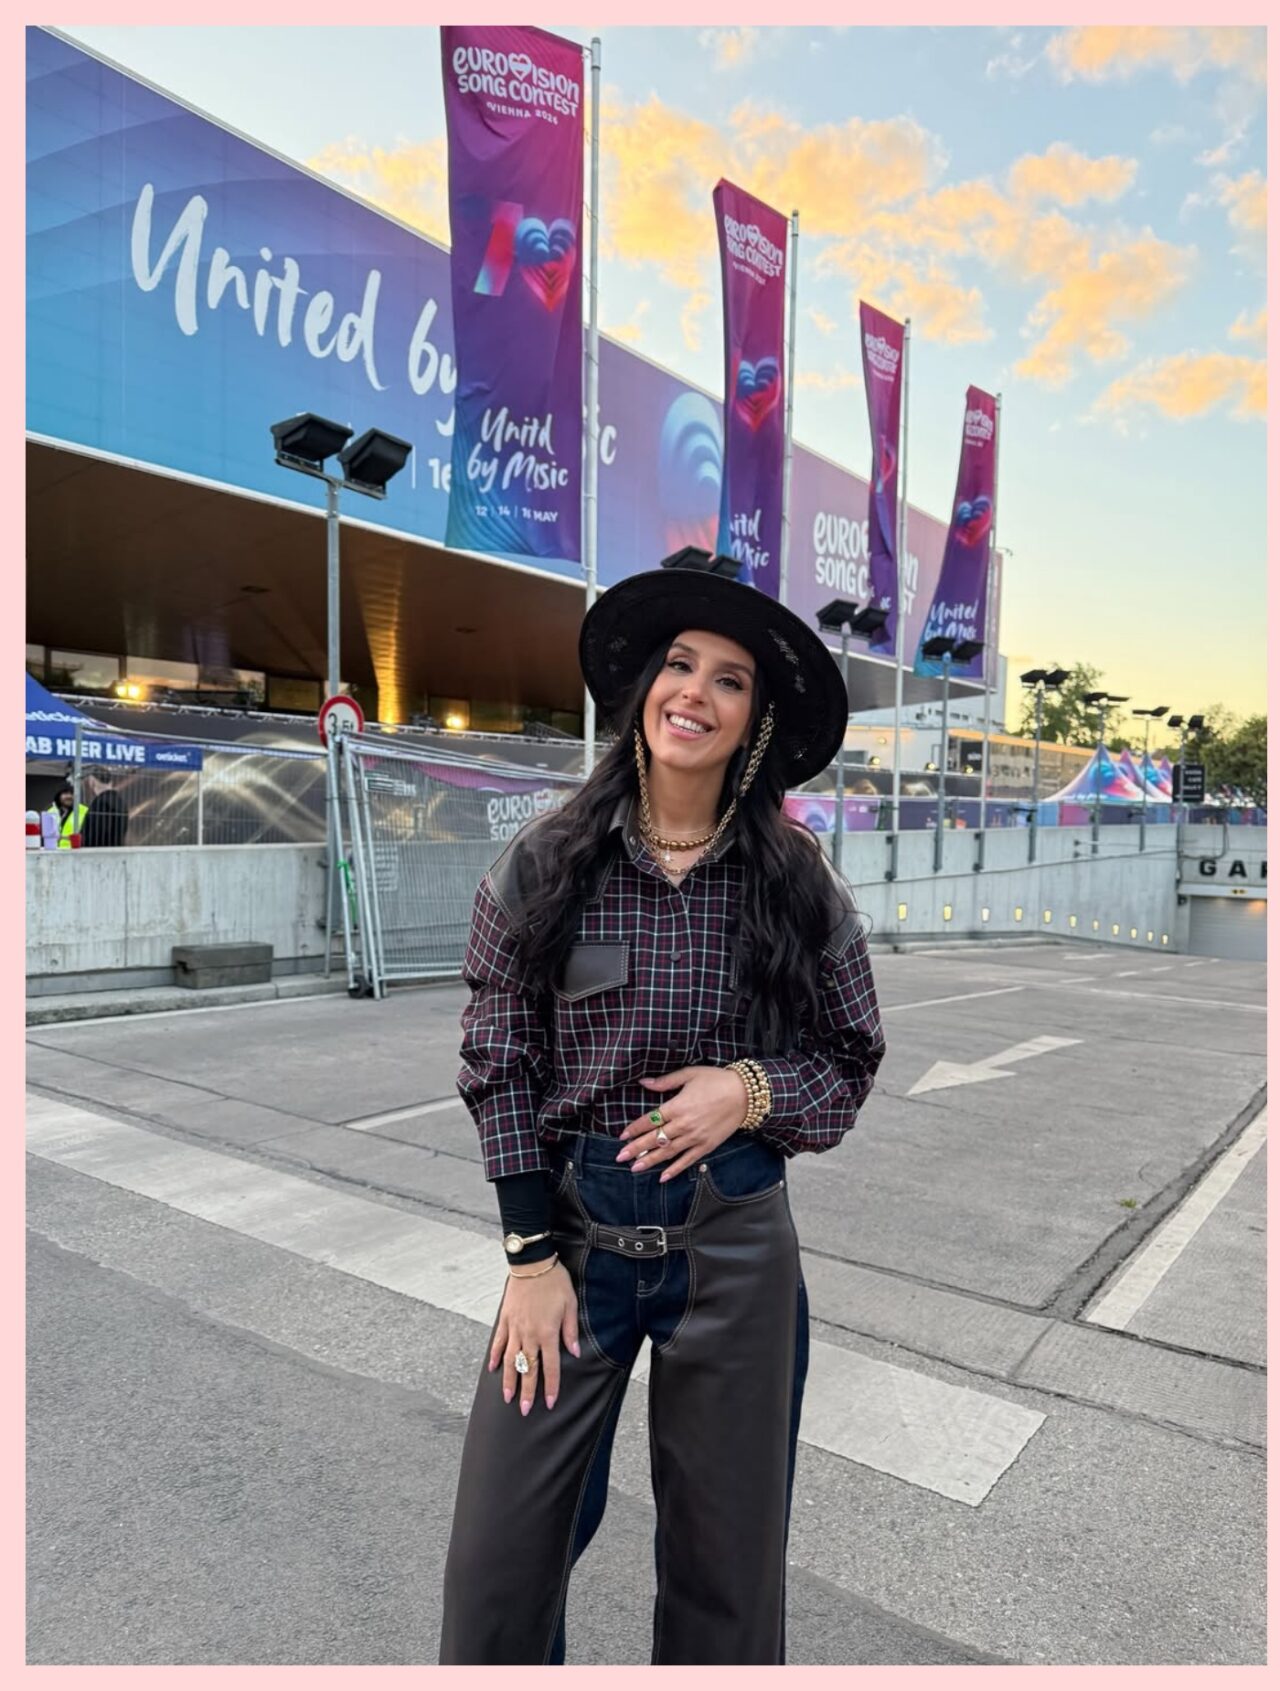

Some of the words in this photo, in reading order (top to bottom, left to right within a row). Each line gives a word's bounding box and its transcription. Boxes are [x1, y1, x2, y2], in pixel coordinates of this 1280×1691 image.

[458, 74, 507, 98] SONG
[508, 80, 578, 117] CONTEST
[131, 183, 391, 391] United
[467, 443, 498, 493] by
[533, 510, 559, 522] MAY
[26, 736, 52, 755] AB
[56, 739, 102, 760] HIER
[106, 743, 146, 763] LIVE
